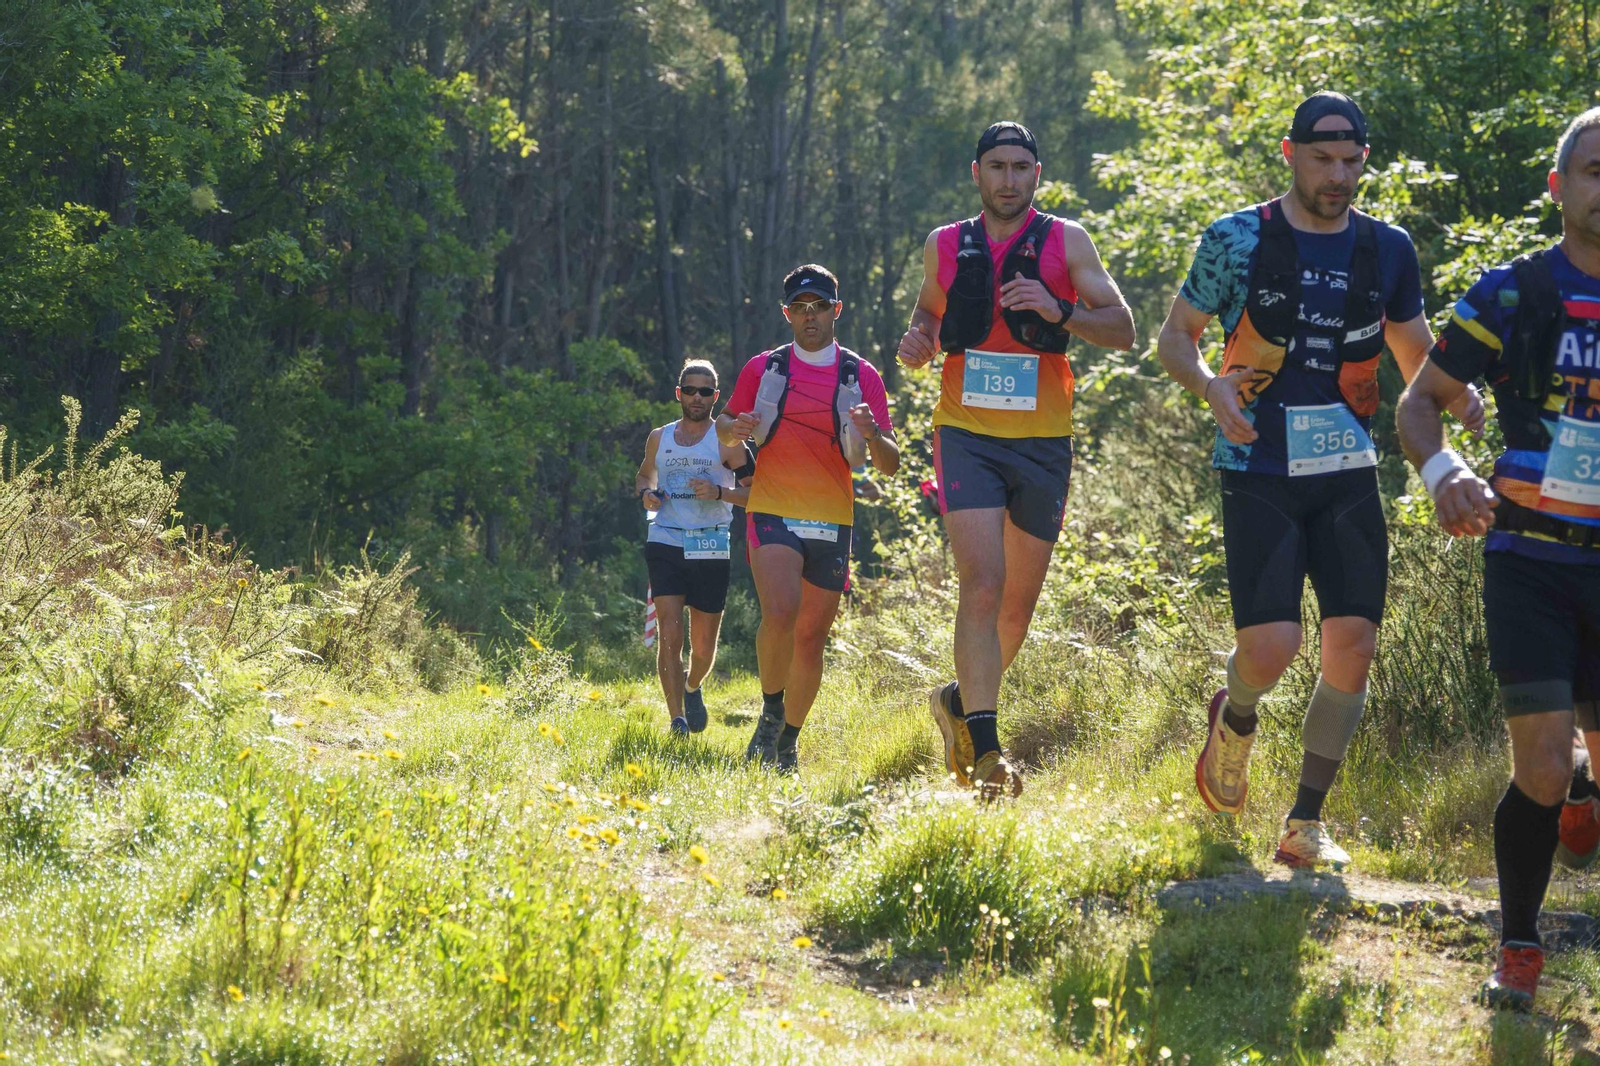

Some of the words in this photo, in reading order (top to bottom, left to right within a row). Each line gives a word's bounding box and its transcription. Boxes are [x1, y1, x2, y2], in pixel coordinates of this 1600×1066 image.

[983, 374, 1016, 393] 139
[1312, 428, 1357, 454] 356
[665, 457, 690, 468] COSTA
[696, 538, 718, 550] 190
